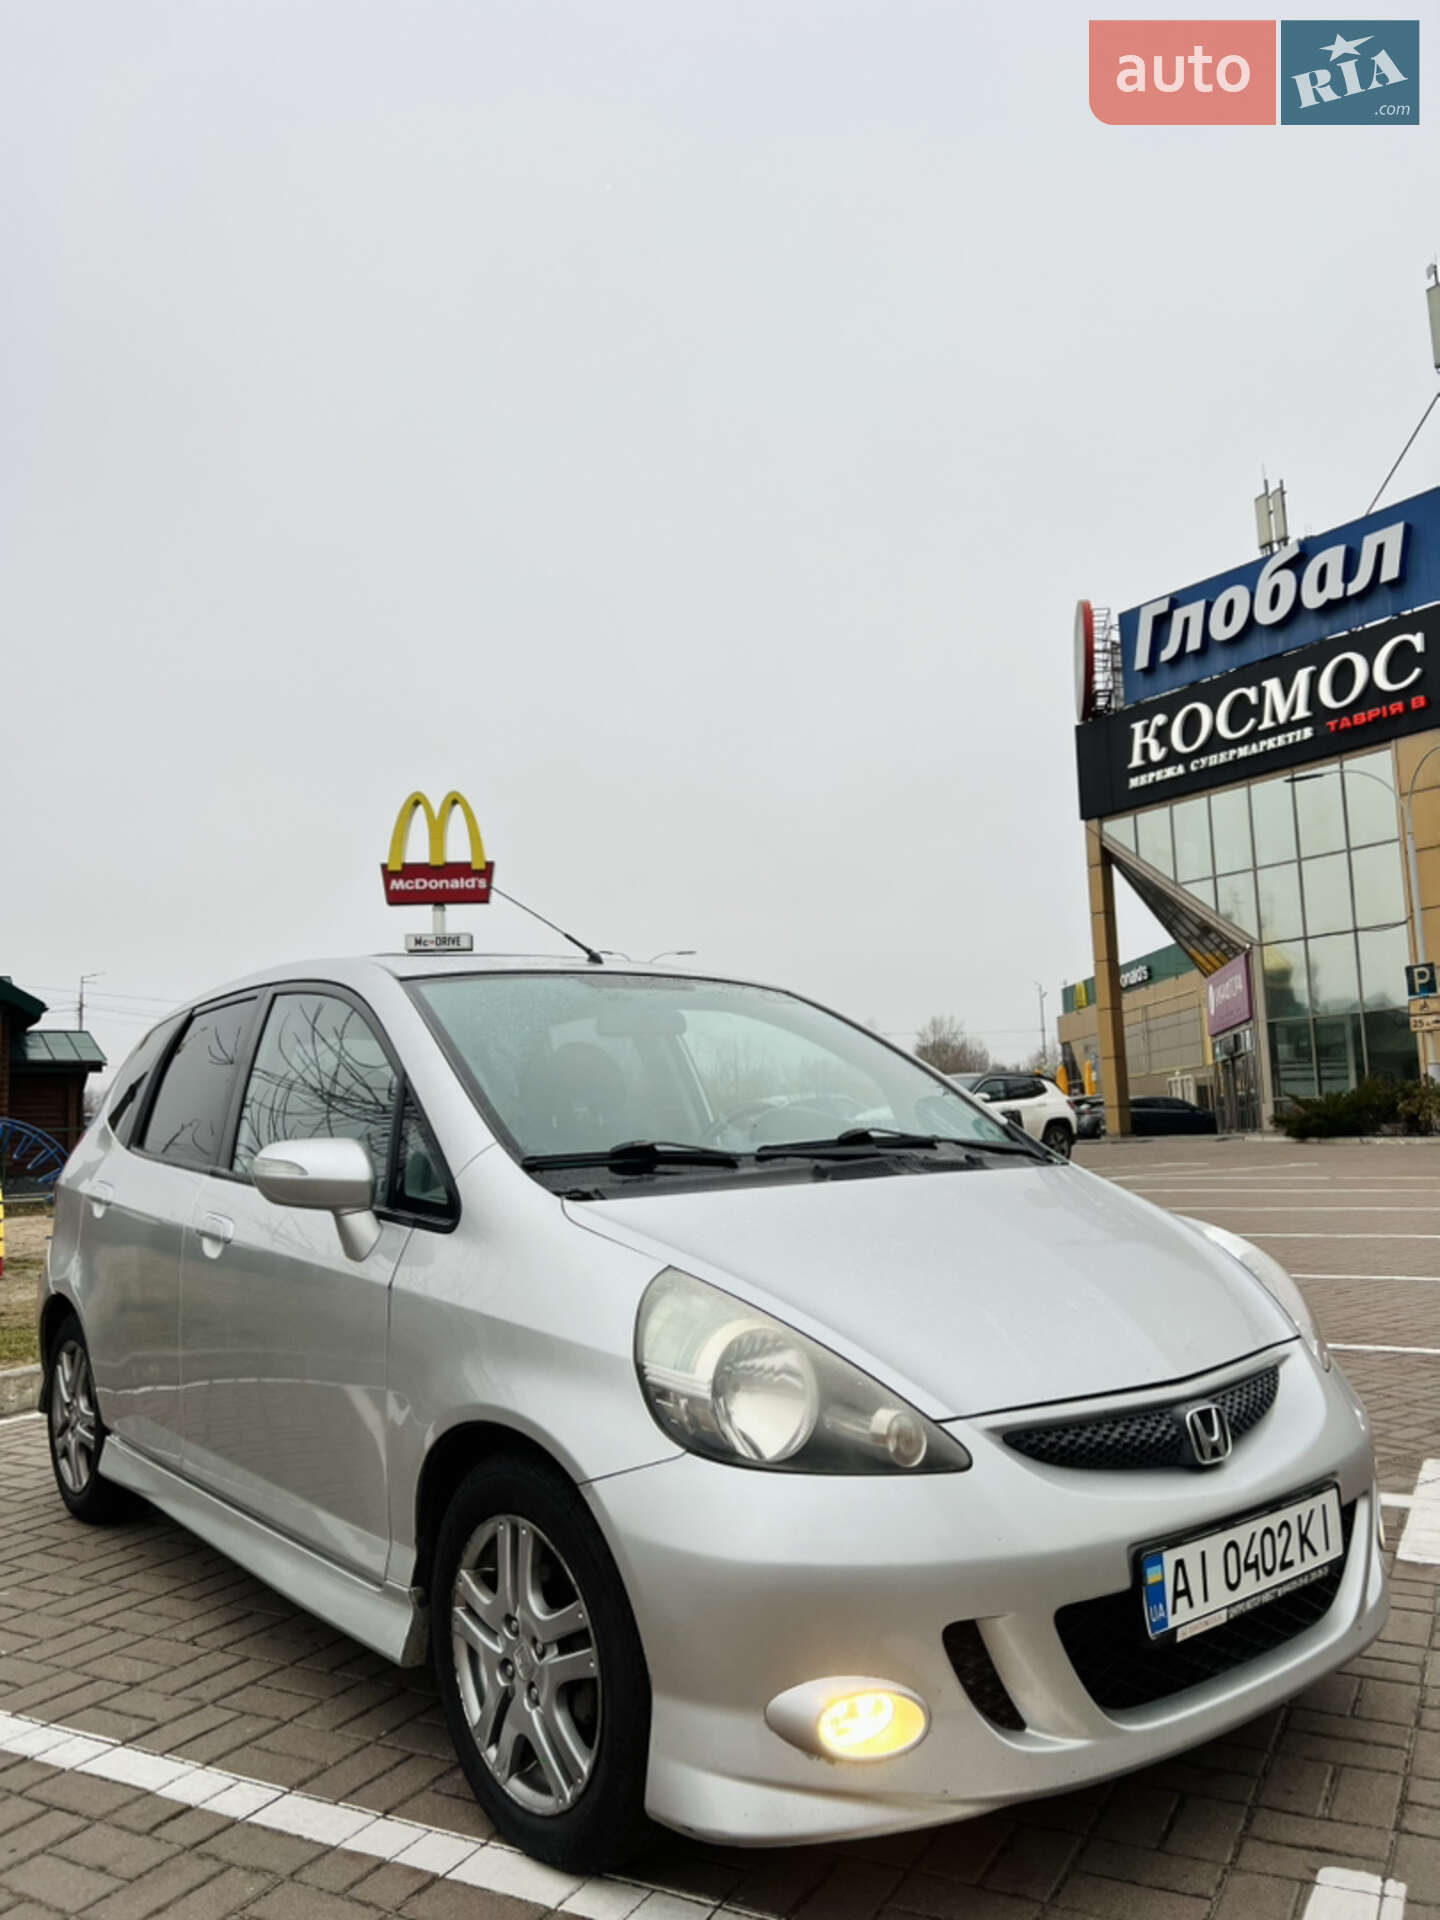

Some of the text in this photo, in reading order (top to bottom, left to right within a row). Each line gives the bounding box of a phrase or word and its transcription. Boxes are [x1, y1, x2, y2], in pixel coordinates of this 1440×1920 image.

[1133, 521, 1406, 672] Глобал
[1127, 632, 1426, 770] КОСМОС
[1326, 701, 1405, 733] ТАВРІЯ
[1128, 726, 1315, 790] МЕРЕЖА СУПЕРМАРКЕТІВ
[389, 877, 488, 891] McDonald's
[1413, 967, 1430, 993] P
